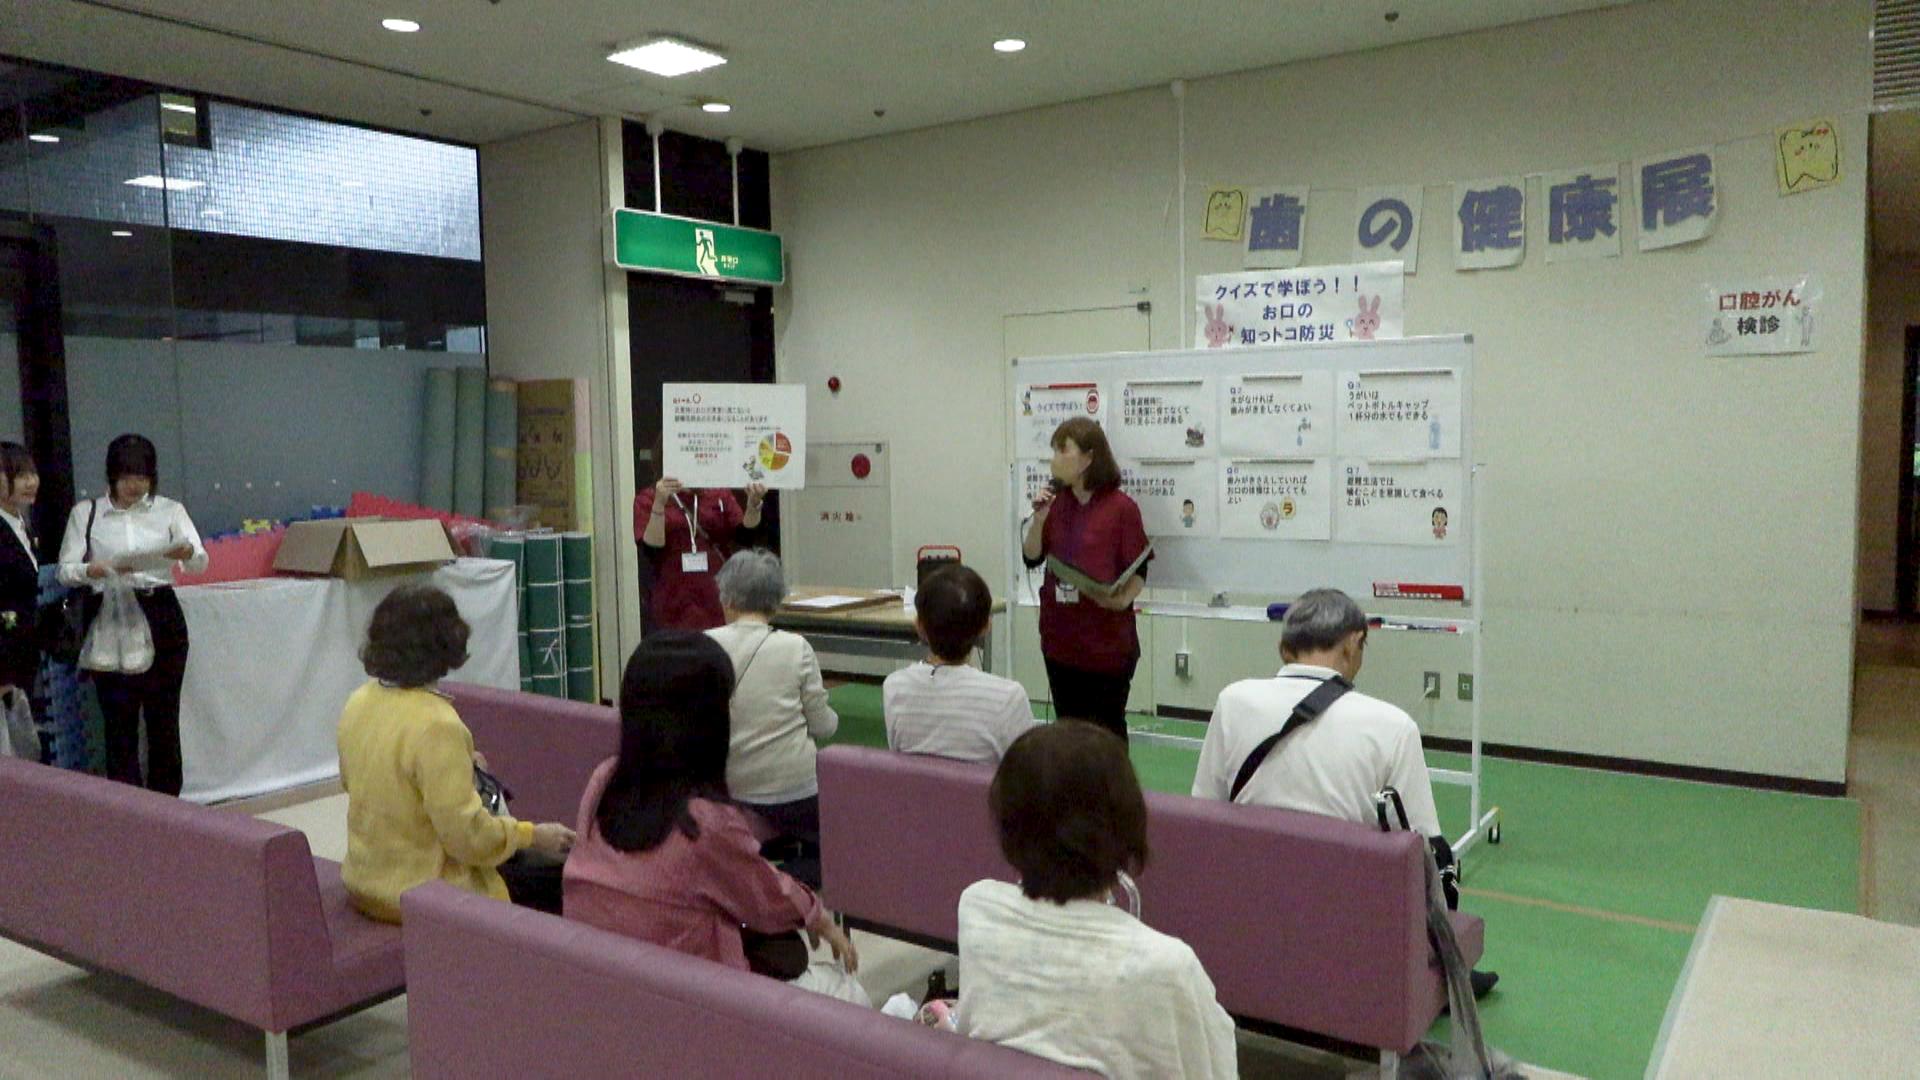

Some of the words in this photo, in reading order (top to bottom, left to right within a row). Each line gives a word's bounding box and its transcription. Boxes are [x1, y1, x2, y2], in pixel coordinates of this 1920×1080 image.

[1248, 152, 1714, 252] 歯の健康展
[1215, 275, 1360, 300] クイズで学ぼう！！
[1719, 288, 1801, 310] 口腔がん
[1262, 303, 1313, 320] お口の
[1240, 323, 1335, 345] 知っトコ防災
[1737, 315, 1780, 336] 検診
[1231, 393, 1274, 404] 水がなければ
[1348, 391, 1378, 400] うがいは
[1347, 399, 1429, 410] ペットボトルキャップ
[1347, 477, 1394, 486] 避難生活では
[1227, 496, 1242, 504] よい
